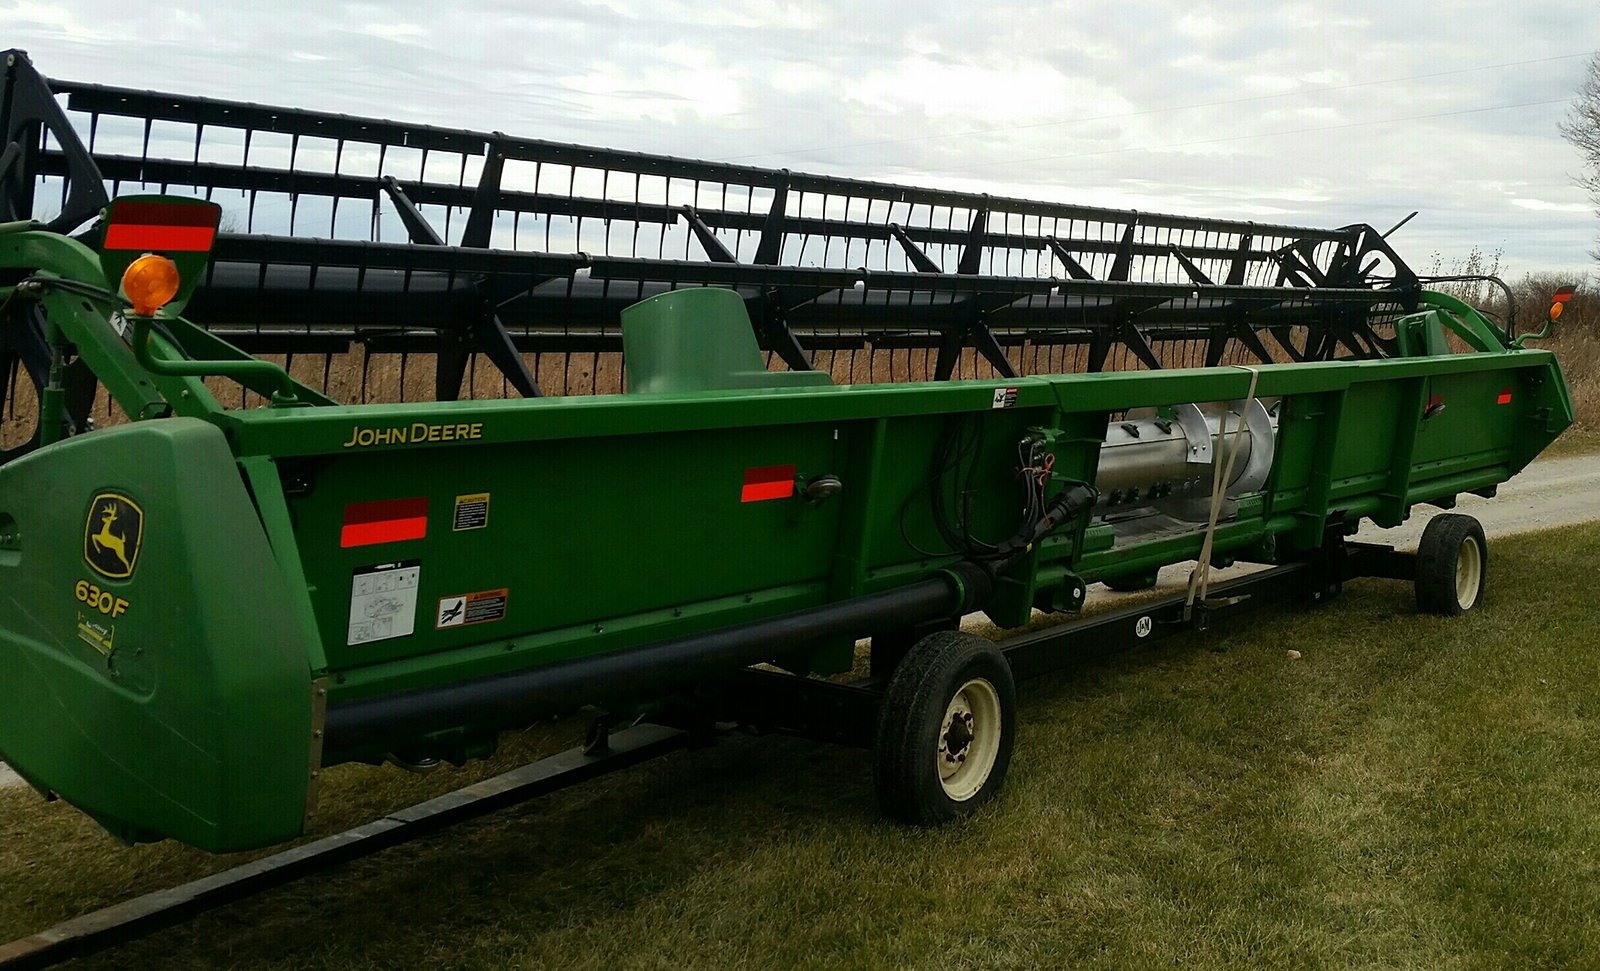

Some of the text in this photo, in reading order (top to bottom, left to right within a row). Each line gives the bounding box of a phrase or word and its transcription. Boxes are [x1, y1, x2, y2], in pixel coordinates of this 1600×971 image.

[343, 423, 483, 447] JOHN DEERE
[75, 580, 129, 618] 630F
